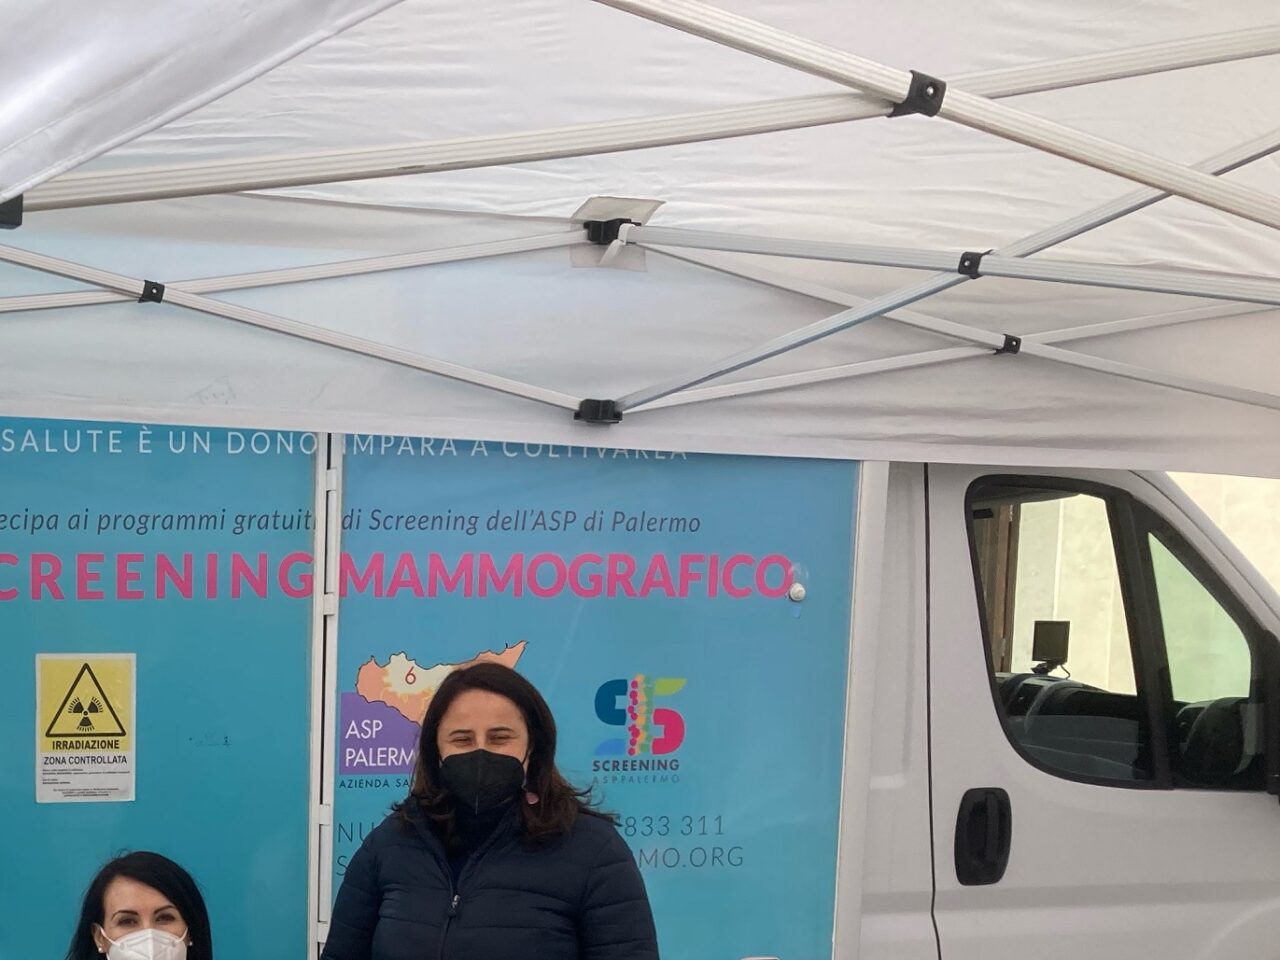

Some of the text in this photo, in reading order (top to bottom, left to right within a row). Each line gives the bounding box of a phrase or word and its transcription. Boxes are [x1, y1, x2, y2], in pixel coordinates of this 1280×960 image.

[1, 429, 123, 454] SALUTE
[138, 425, 154, 454] È
[168, 430, 212, 455] UN
[226, 431, 318, 455] DONO
[470, 440, 489, 457] A
[67, 508, 90, 531] ai
[96, 508, 227, 536] programmi
[342, 508, 362, 531] di
[368, 508, 479, 535] Screening
[583, 509, 605, 532] di
[612, 510, 702, 533] Palermo
[339, 551, 795, 599] MAMMOGRAFICO
[404, 665, 417, 686] 6
[344, 719, 384, 740] ASP
[51, 739, 120, 750] IRRADIAZIONE
[43, 755, 128, 766] ZONA CONTROLLATA
[344, 746, 417, 768] PALERM
[592, 758, 680, 772] SCREENING
[338, 778, 390, 789] AZIENDA
[623, 815, 726, 837] 833 311
[638, 846, 744, 869] MO.ORG
